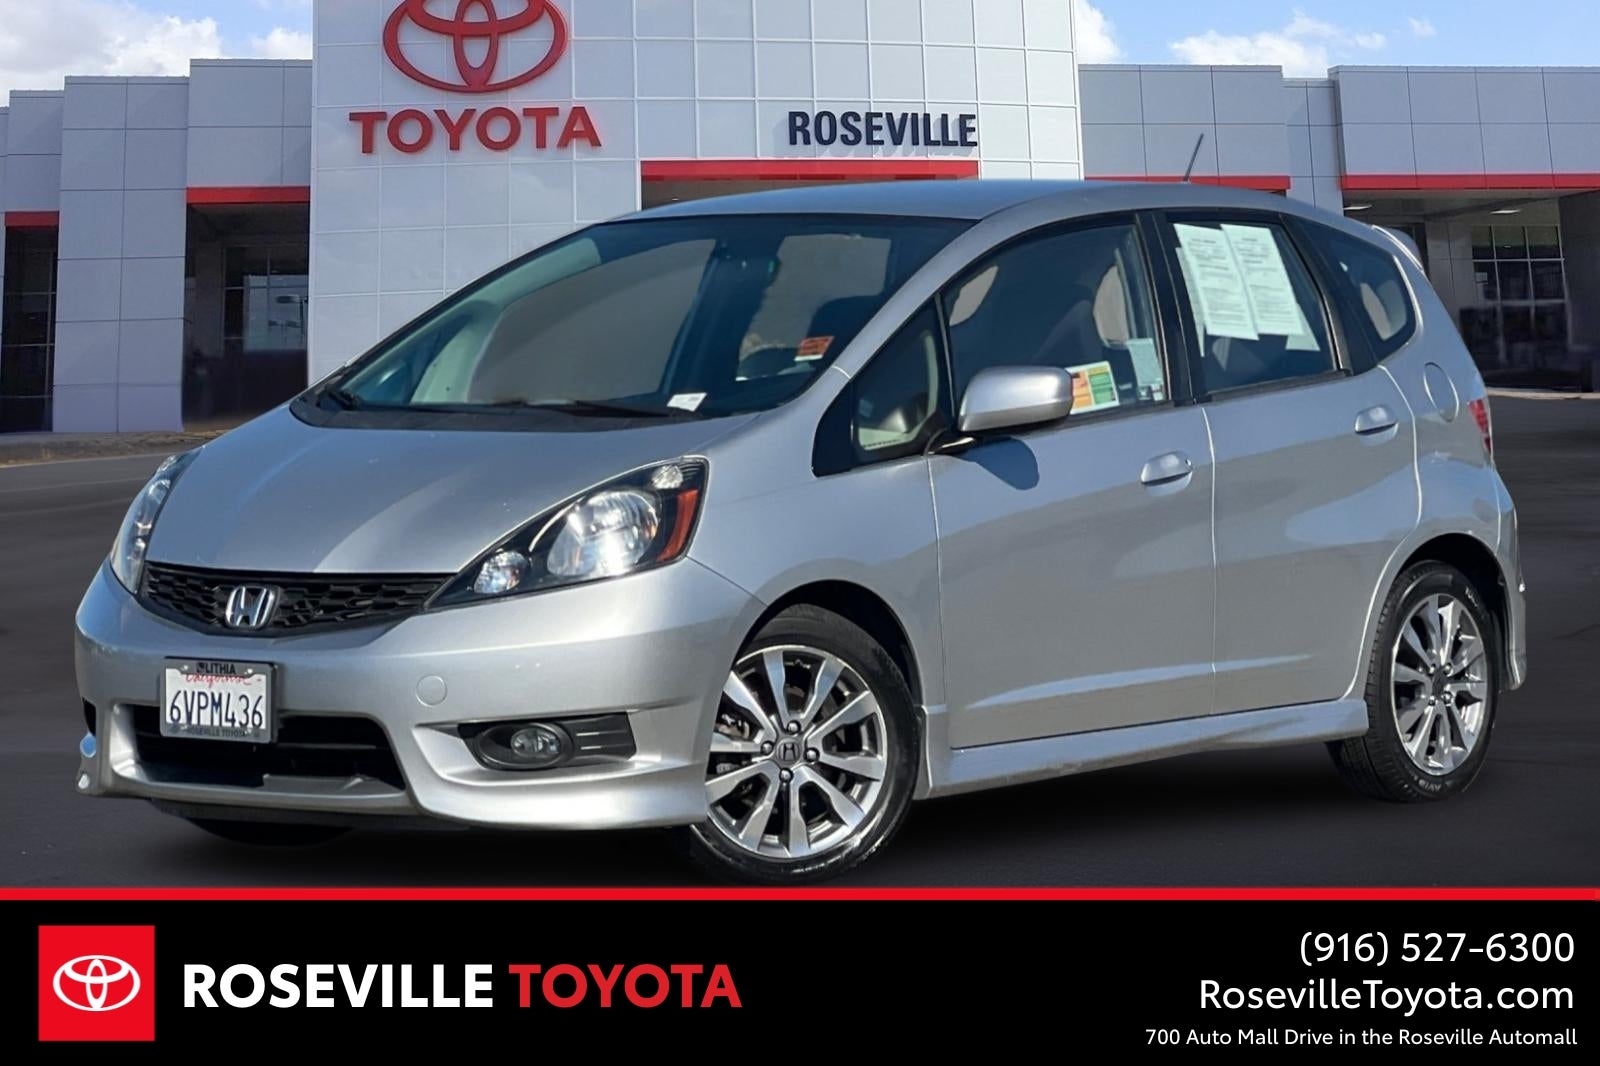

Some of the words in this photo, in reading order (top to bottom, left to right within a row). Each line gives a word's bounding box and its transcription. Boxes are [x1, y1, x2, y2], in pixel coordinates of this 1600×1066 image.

[349, 106, 602, 154] TOYOTA
[788, 110, 978, 147] ROSEVILLE
[170, 690, 263, 728] 6VPM436
